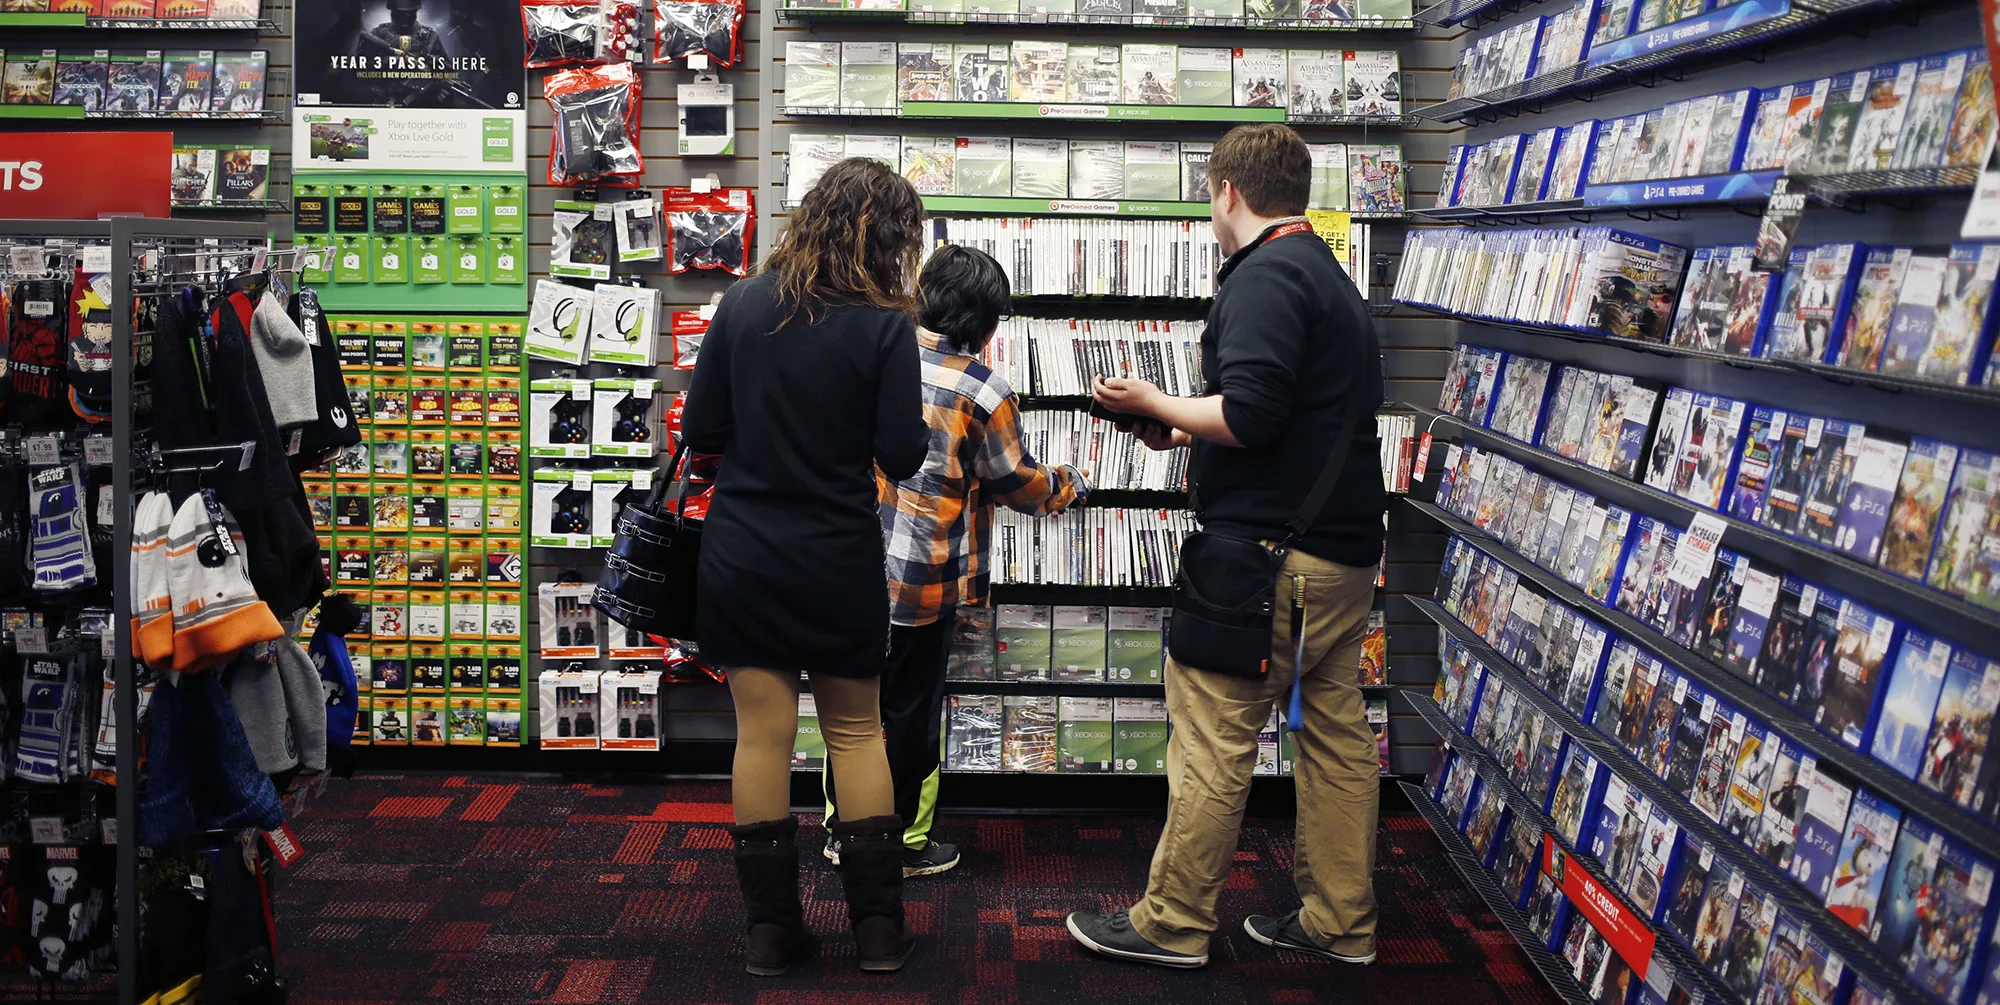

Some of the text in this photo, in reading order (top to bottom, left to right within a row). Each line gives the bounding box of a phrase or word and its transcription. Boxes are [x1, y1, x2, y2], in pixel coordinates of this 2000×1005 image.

[1655, 32, 1668, 45] PS4
[330, 56, 487, 70] YEAR 3 PASS IS HERE
[186, 72, 211, 82] HAPPY
[444, 72, 459, 80] MORE
[388, 120, 466, 130] Play together with
[388, 132, 454, 142] Xbox Live Gold
[1188, 154, 1205, 162] CALL
[226, 179, 254, 188] PILLARS
[1774, 178, 1789, 194] 3X
[1650, 188, 1664, 197] PS4
[376, 201, 402, 209] GAMES
[414, 202, 439, 210] GAMES
[1768, 194, 1806, 210] POINTS
[1326, 238, 1345, 250] EE
[1623, 237, 1645, 247] PS4
[1632, 263, 1651, 271] JAM
[14, 373, 49, 398] RDER
[1628, 432, 1640, 444] PS4
[32, 444, 52, 452] $7.99
[40, 468, 64, 476] STAR
[38, 473, 65, 484] WARS
[1862, 500, 1885, 516] PS4
[1667, 530, 1675, 538] PS4
[1690, 524, 1719, 544] INCREASE
[1687, 536, 1712, 552] STORAGE
[1722, 552, 1732, 561] PS4
[1744, 624, 1761, 640] PS4
[1123, 640, 1156, 648] XBOX 360
[34, 666, 60, 675] WARS
[1721, 709, 1730, 717] PS4
[1752, 727, 1762, 737] PS4
[268, 825, 296, 860] MARVEL
[1814, 836, 1834, 855] PS4
[46, 847, 78, 859] MARVEL
[1584, 880, 1596, 899] 40%
[1597, 892, 1619, 921] CREDIT
